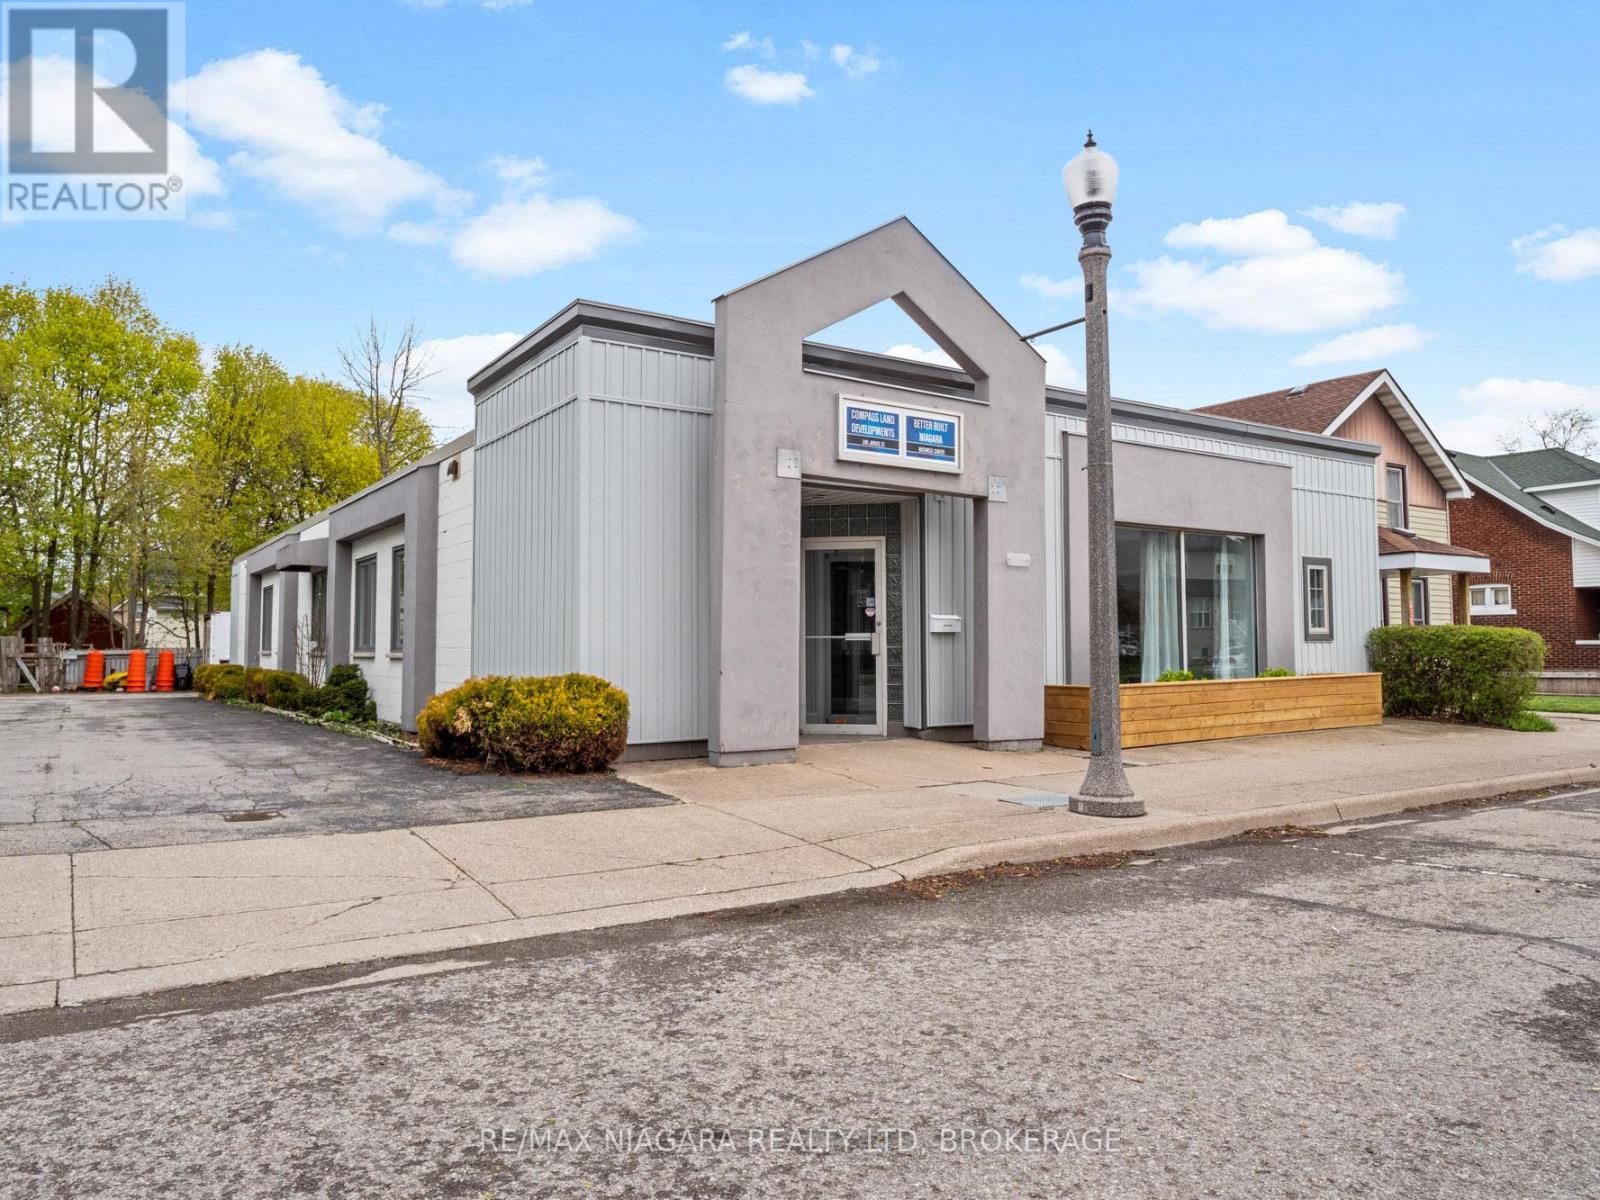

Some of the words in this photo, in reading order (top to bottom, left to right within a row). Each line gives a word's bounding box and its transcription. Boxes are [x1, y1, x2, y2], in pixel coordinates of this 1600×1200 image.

[851, 410, 879, 422] COMPASS
[880, 413, 895, 425] LAND
[851, 423, 895, 438] DEVELOPMENTS
[913, 418, 933, 430] BETTER
[934, 422, 948, 433] BUILT
[919, 433, 943, 444] NIAGARA
